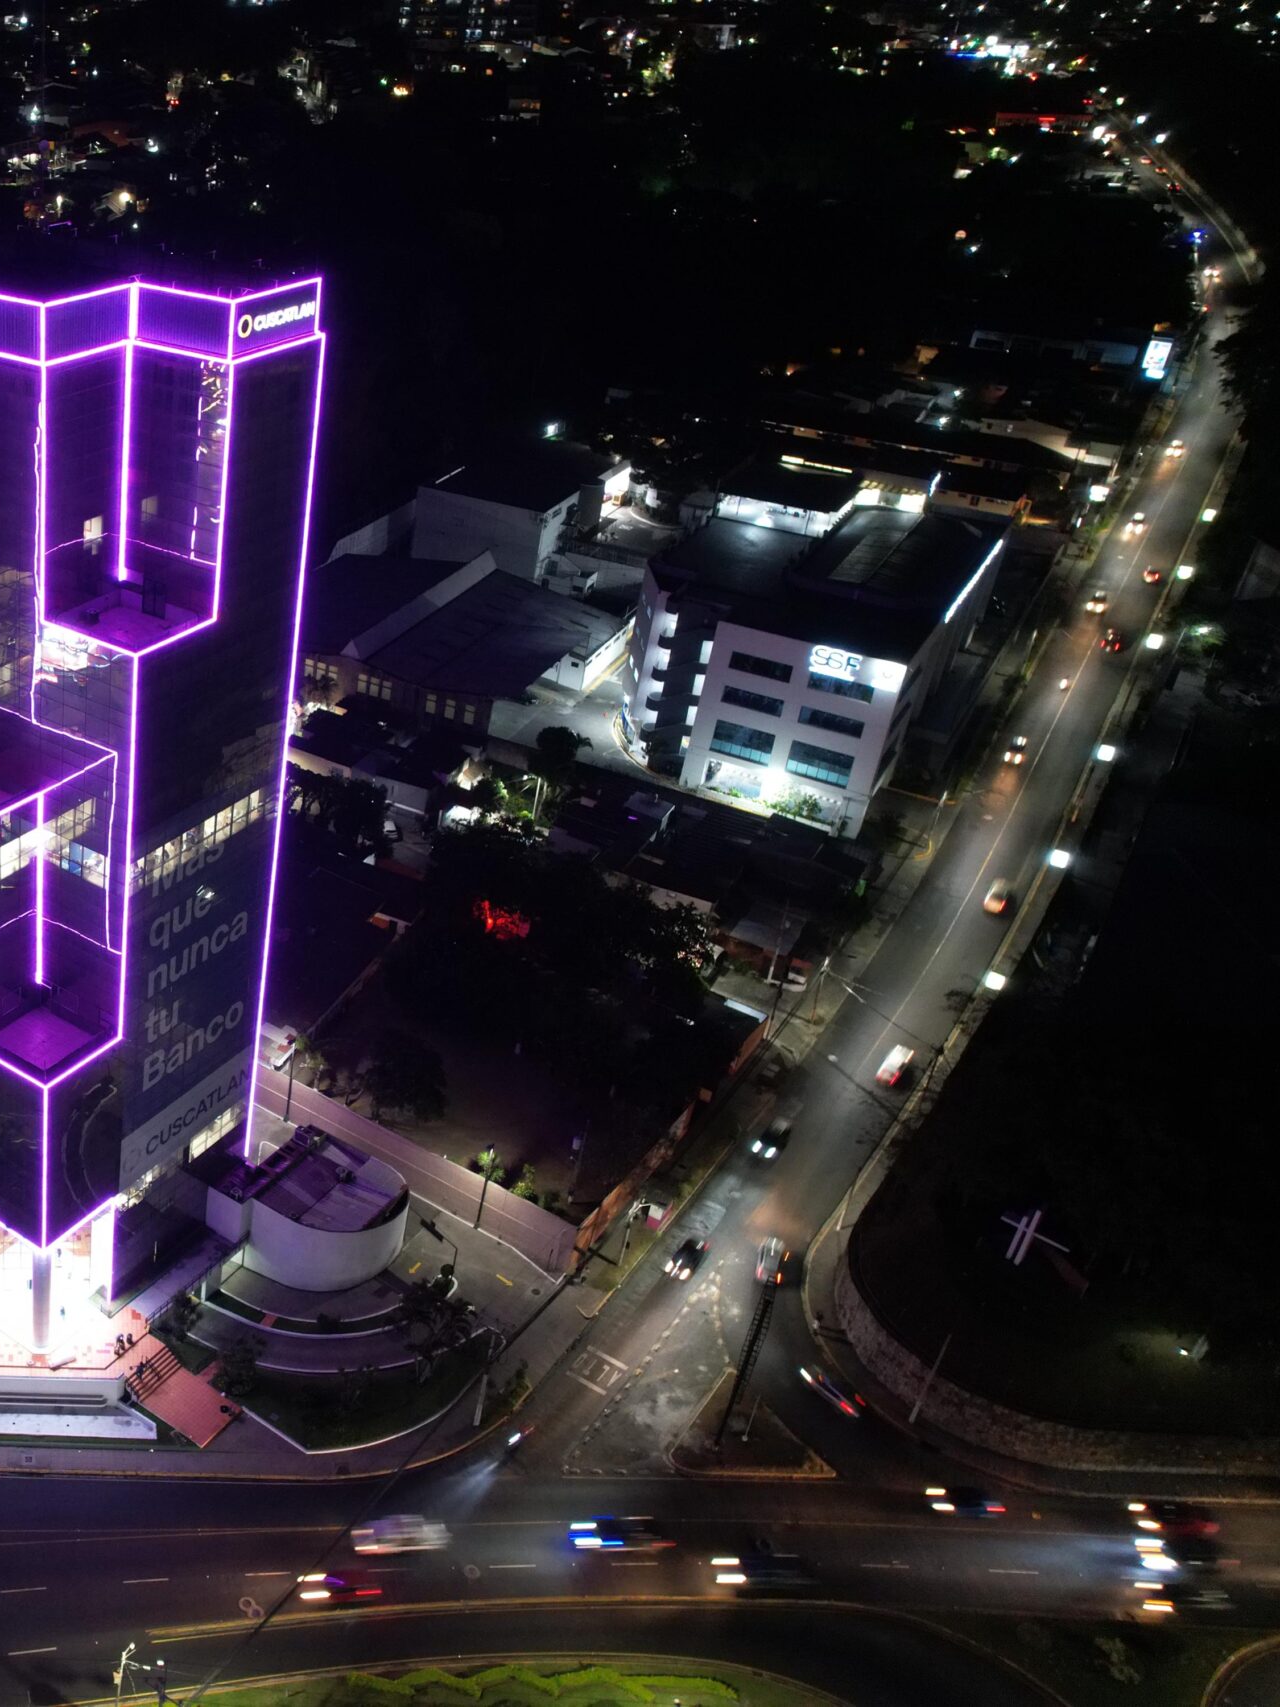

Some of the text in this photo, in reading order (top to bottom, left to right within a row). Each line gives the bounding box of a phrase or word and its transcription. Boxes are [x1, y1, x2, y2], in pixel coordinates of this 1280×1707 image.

[253, 301, 316, 331] CUSCATLAN
[813, 646, 862, 672] SSF
[149, 887, 212, 950] que
[148, 911, 248, 999] nunca
[143, 1001, 244, 1092] Banco
[145, 1000, 179, 1043] tu
[146, 1069, 249, 1154] CUSCATLAN
[572, 1353, 622, 1387] ALTO
